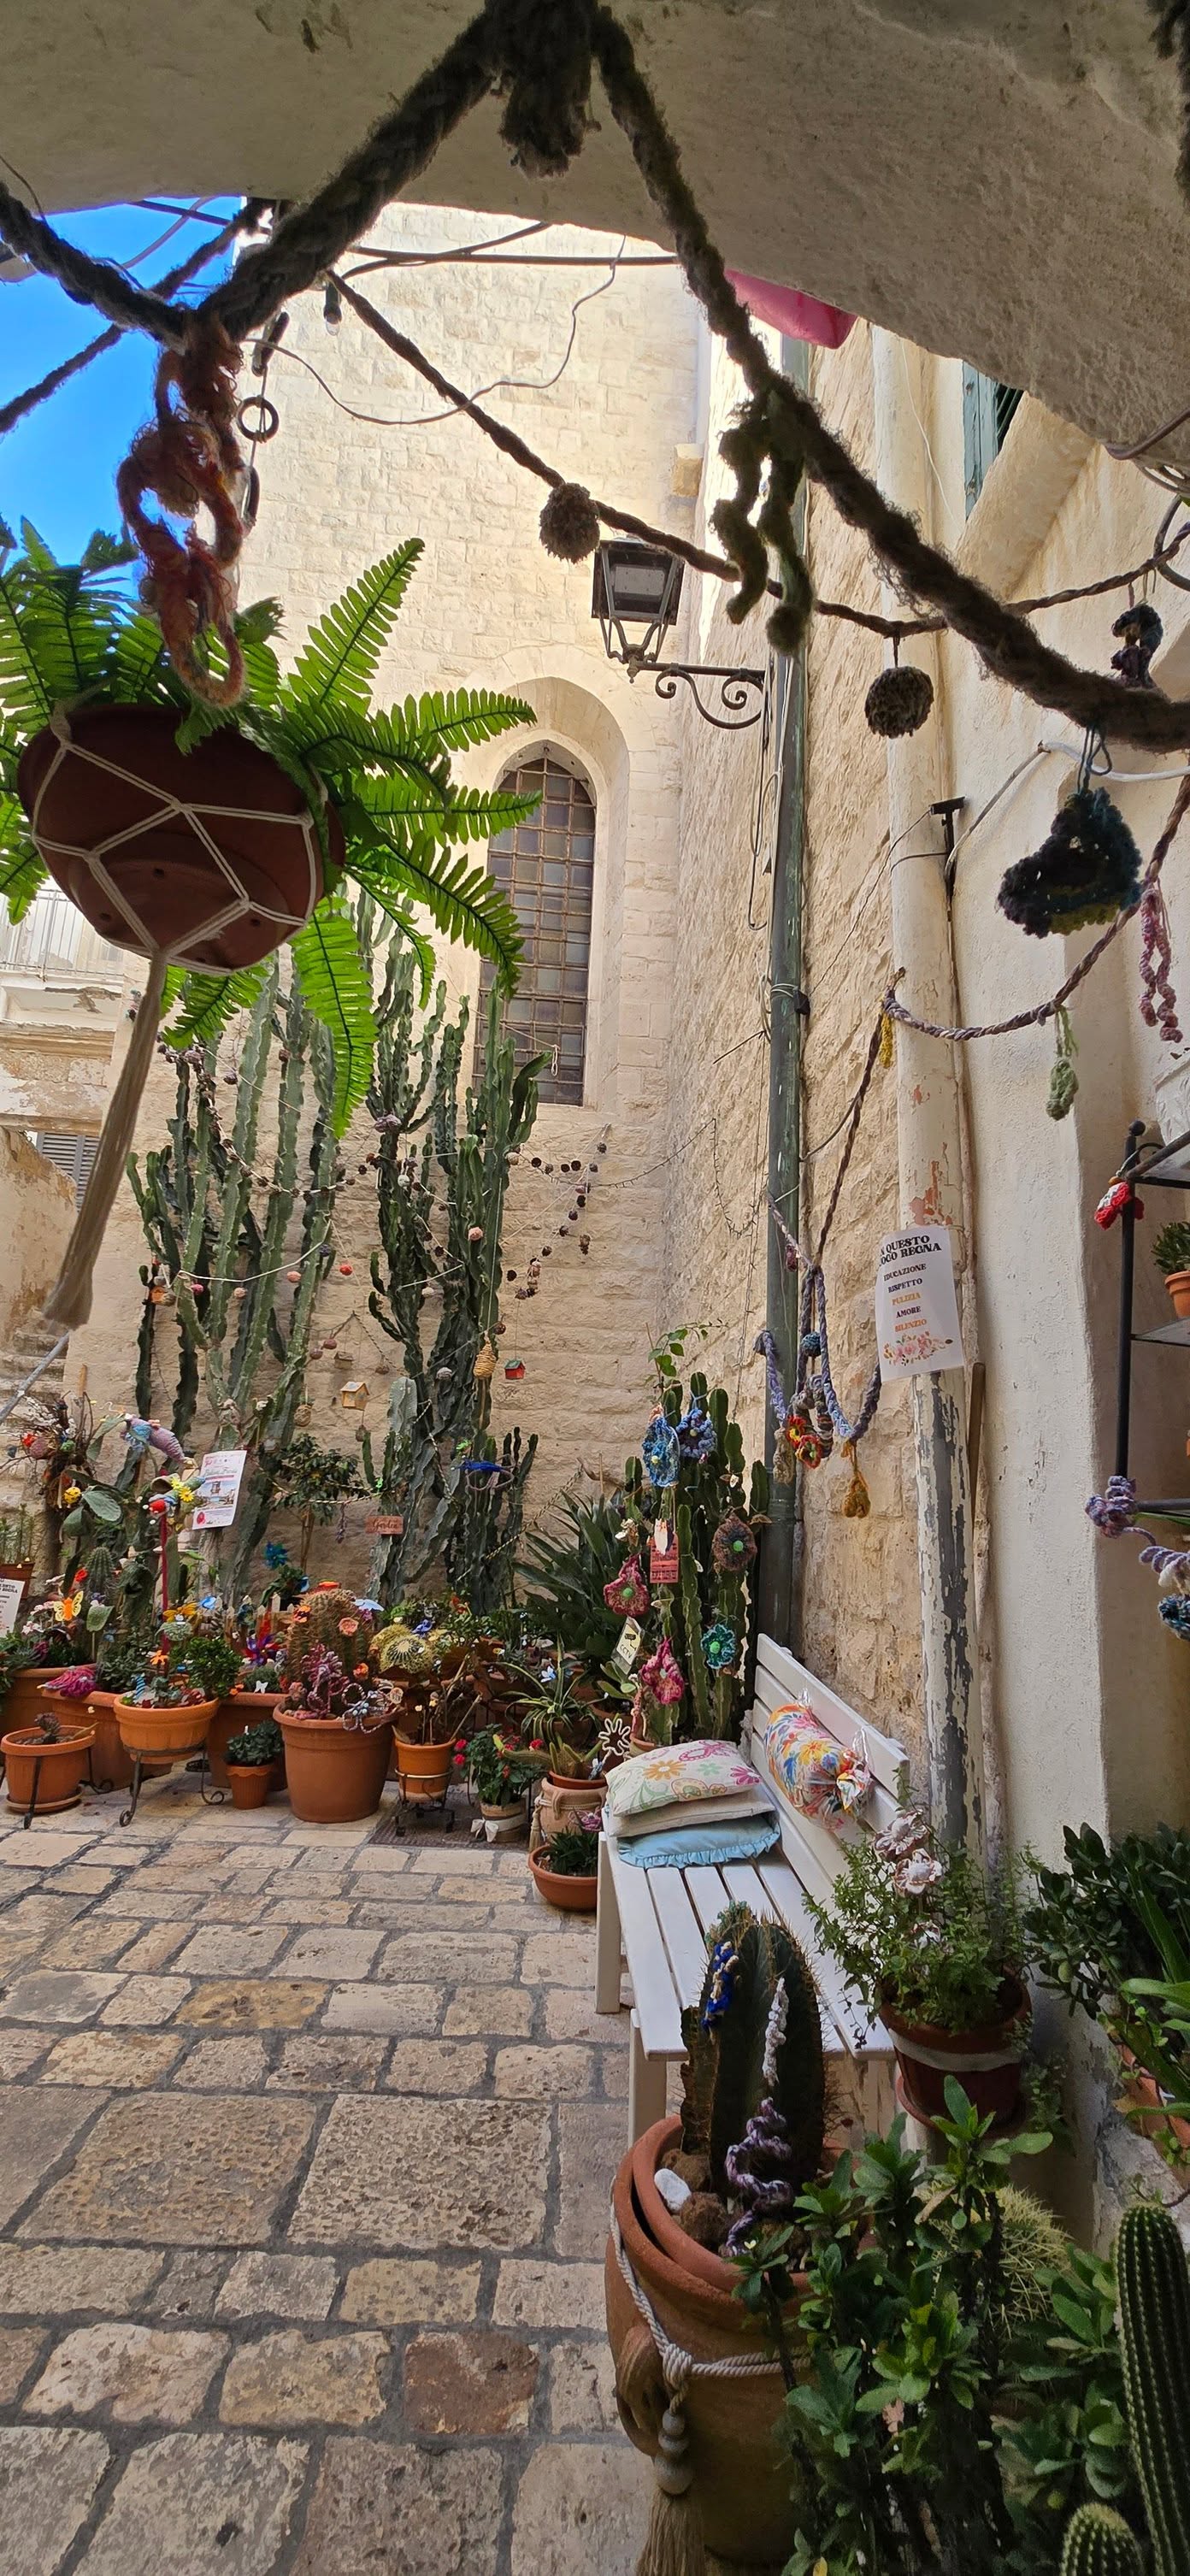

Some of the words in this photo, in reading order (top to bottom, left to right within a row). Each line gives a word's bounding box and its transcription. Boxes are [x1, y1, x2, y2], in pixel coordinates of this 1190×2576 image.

[886, 1235, 930, 1253] QUESTO
[900, 1242, 942, 1258] REGNA
[884, 1263, 927, 1282] EDUCAZIONE
[888, 1277, 923, 1294] RISPETTO
[892, 1292, 922, 1306] PULIZIA
[896, 1306, 922, 1318] AMORE
[895, 1318, 928, 1333] SILENZIO
[620, 1644, 633, 1659] CCTV
